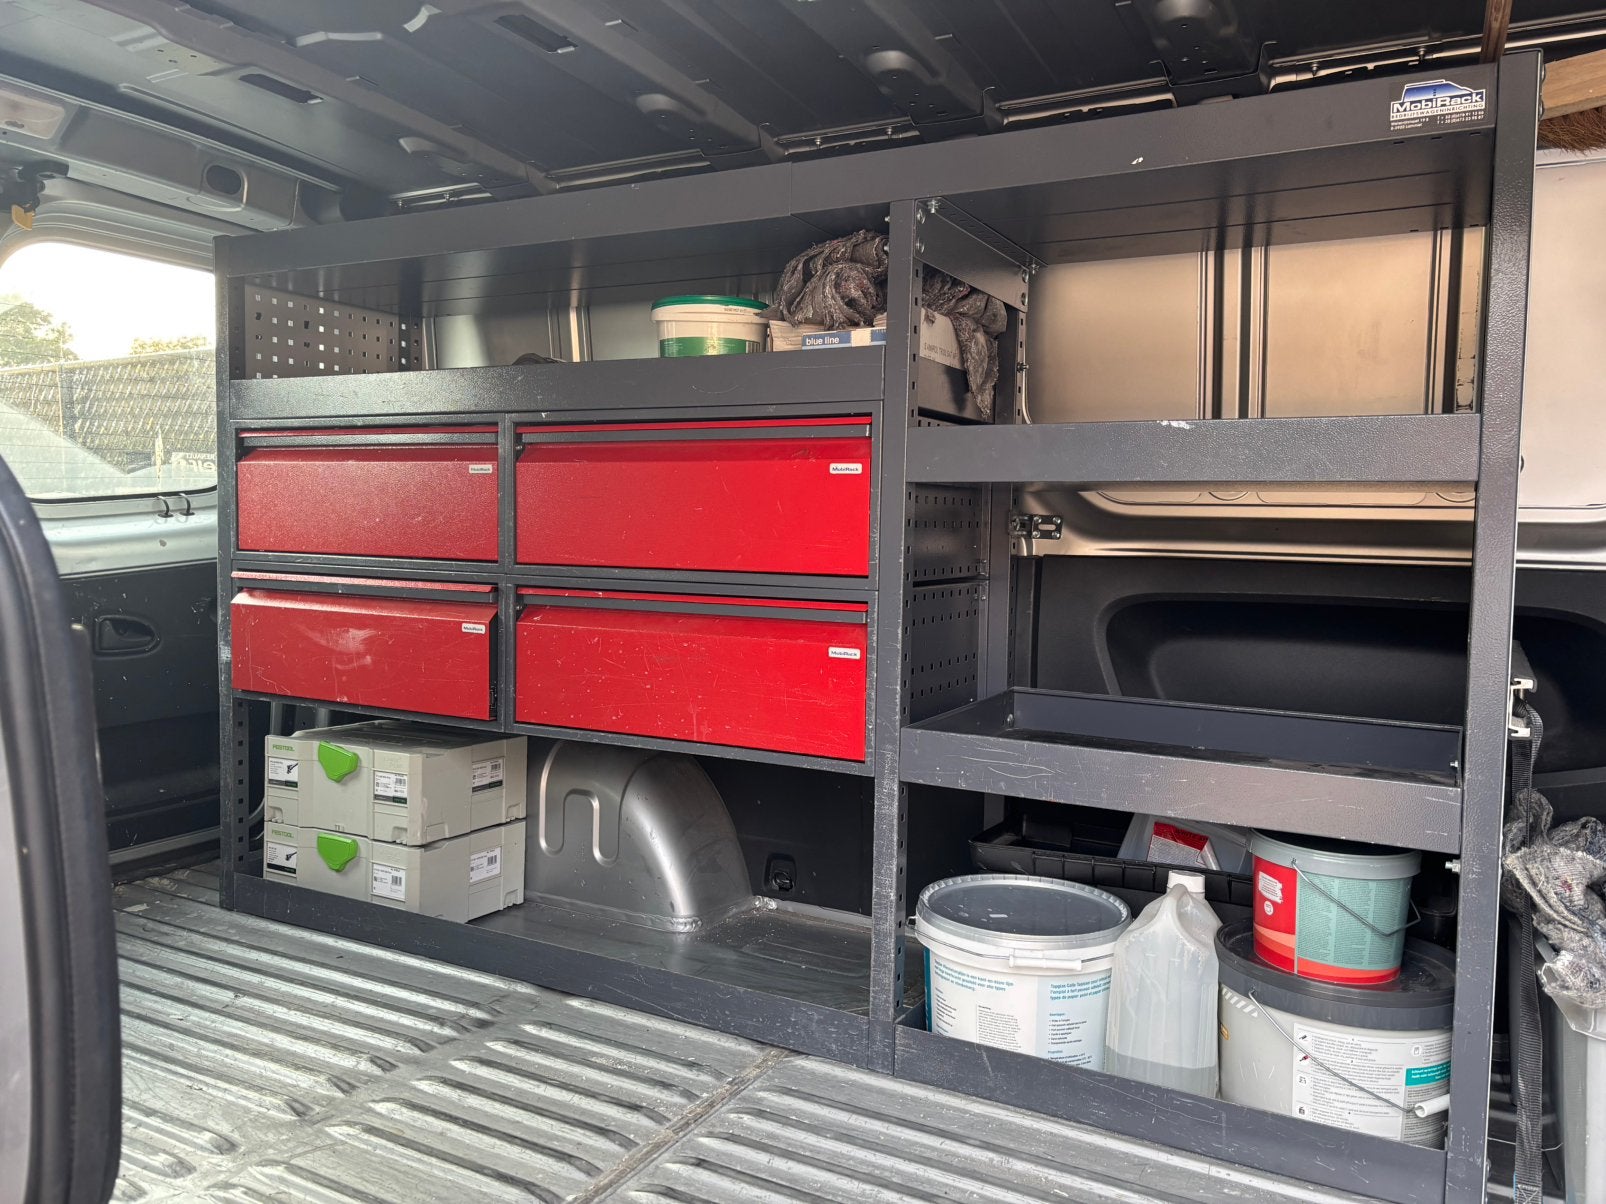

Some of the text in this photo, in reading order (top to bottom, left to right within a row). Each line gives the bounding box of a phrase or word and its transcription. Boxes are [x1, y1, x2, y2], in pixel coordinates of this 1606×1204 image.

[1393, 92, 1482, 113] MobiRack
[1391, 104, 1484, 119] BEDRIJFSWAGENINRICHTING
[806, 336, 840, 346] blue line
[272, 744, 295, 752] FESTOOL
[272, 829, 294, 838] FESTOOL
